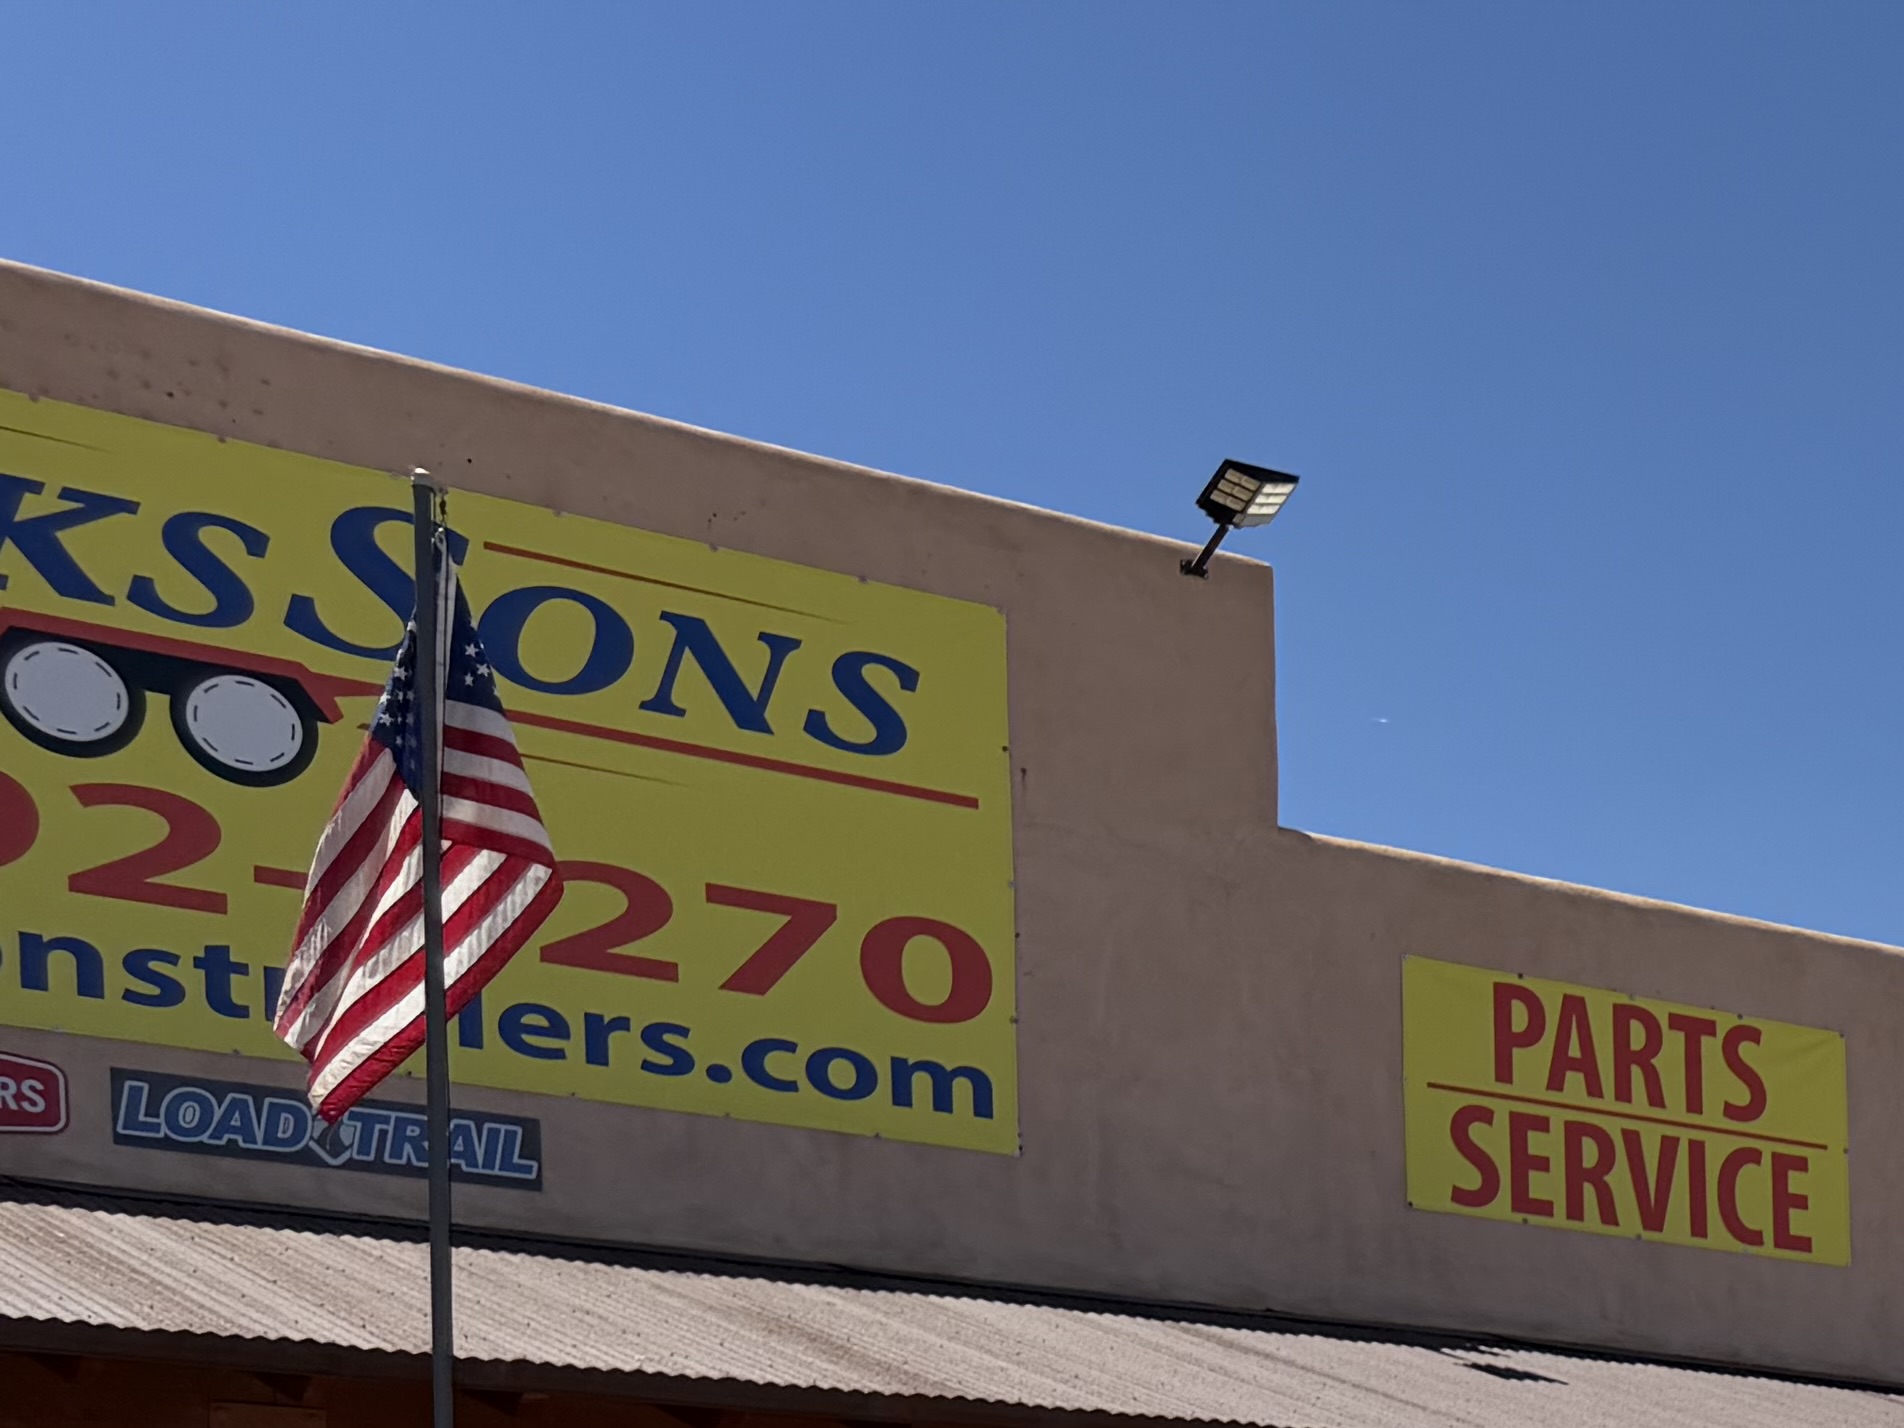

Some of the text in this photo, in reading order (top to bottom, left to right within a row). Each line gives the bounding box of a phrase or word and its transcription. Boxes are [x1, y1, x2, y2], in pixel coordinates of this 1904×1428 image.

[1492, 981, 1767, 1122] PARTS
[116, 1079, 539, 1180] LOAD TRAIL
[1449, 1104, 1813, 1253] SERVICE
